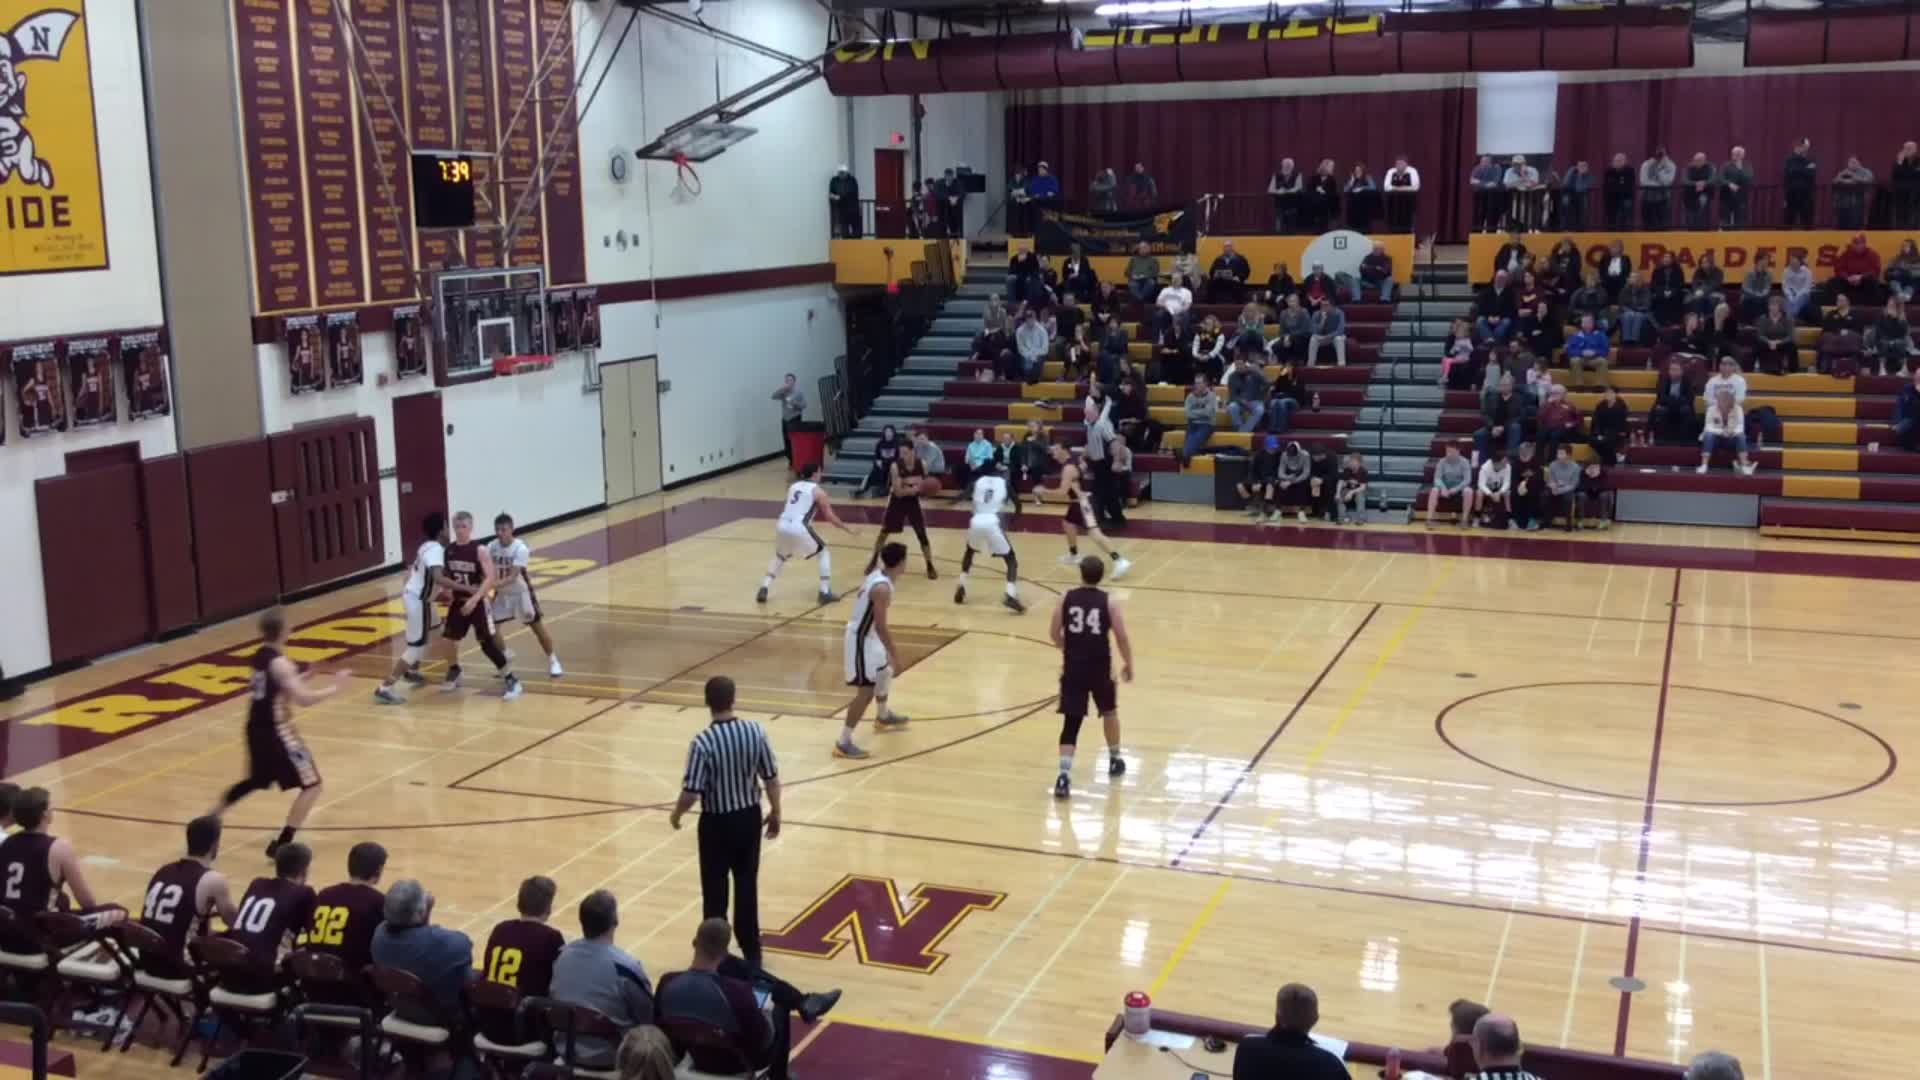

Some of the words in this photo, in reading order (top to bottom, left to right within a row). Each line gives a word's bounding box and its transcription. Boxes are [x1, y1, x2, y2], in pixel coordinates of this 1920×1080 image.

[29, 26, 50, 51] N
[438, 160, 469, 183] 7:39
[1068, 606, 1101, 635] 34
[5, 861, 25, 899] 2
[143, 881, 184, 924] 42
[233, 895, 276, 934] 10
[310, 904, 350, 945] 32
[758, 873, 1009, 976] N
[487, 945, 523, 988] 12
